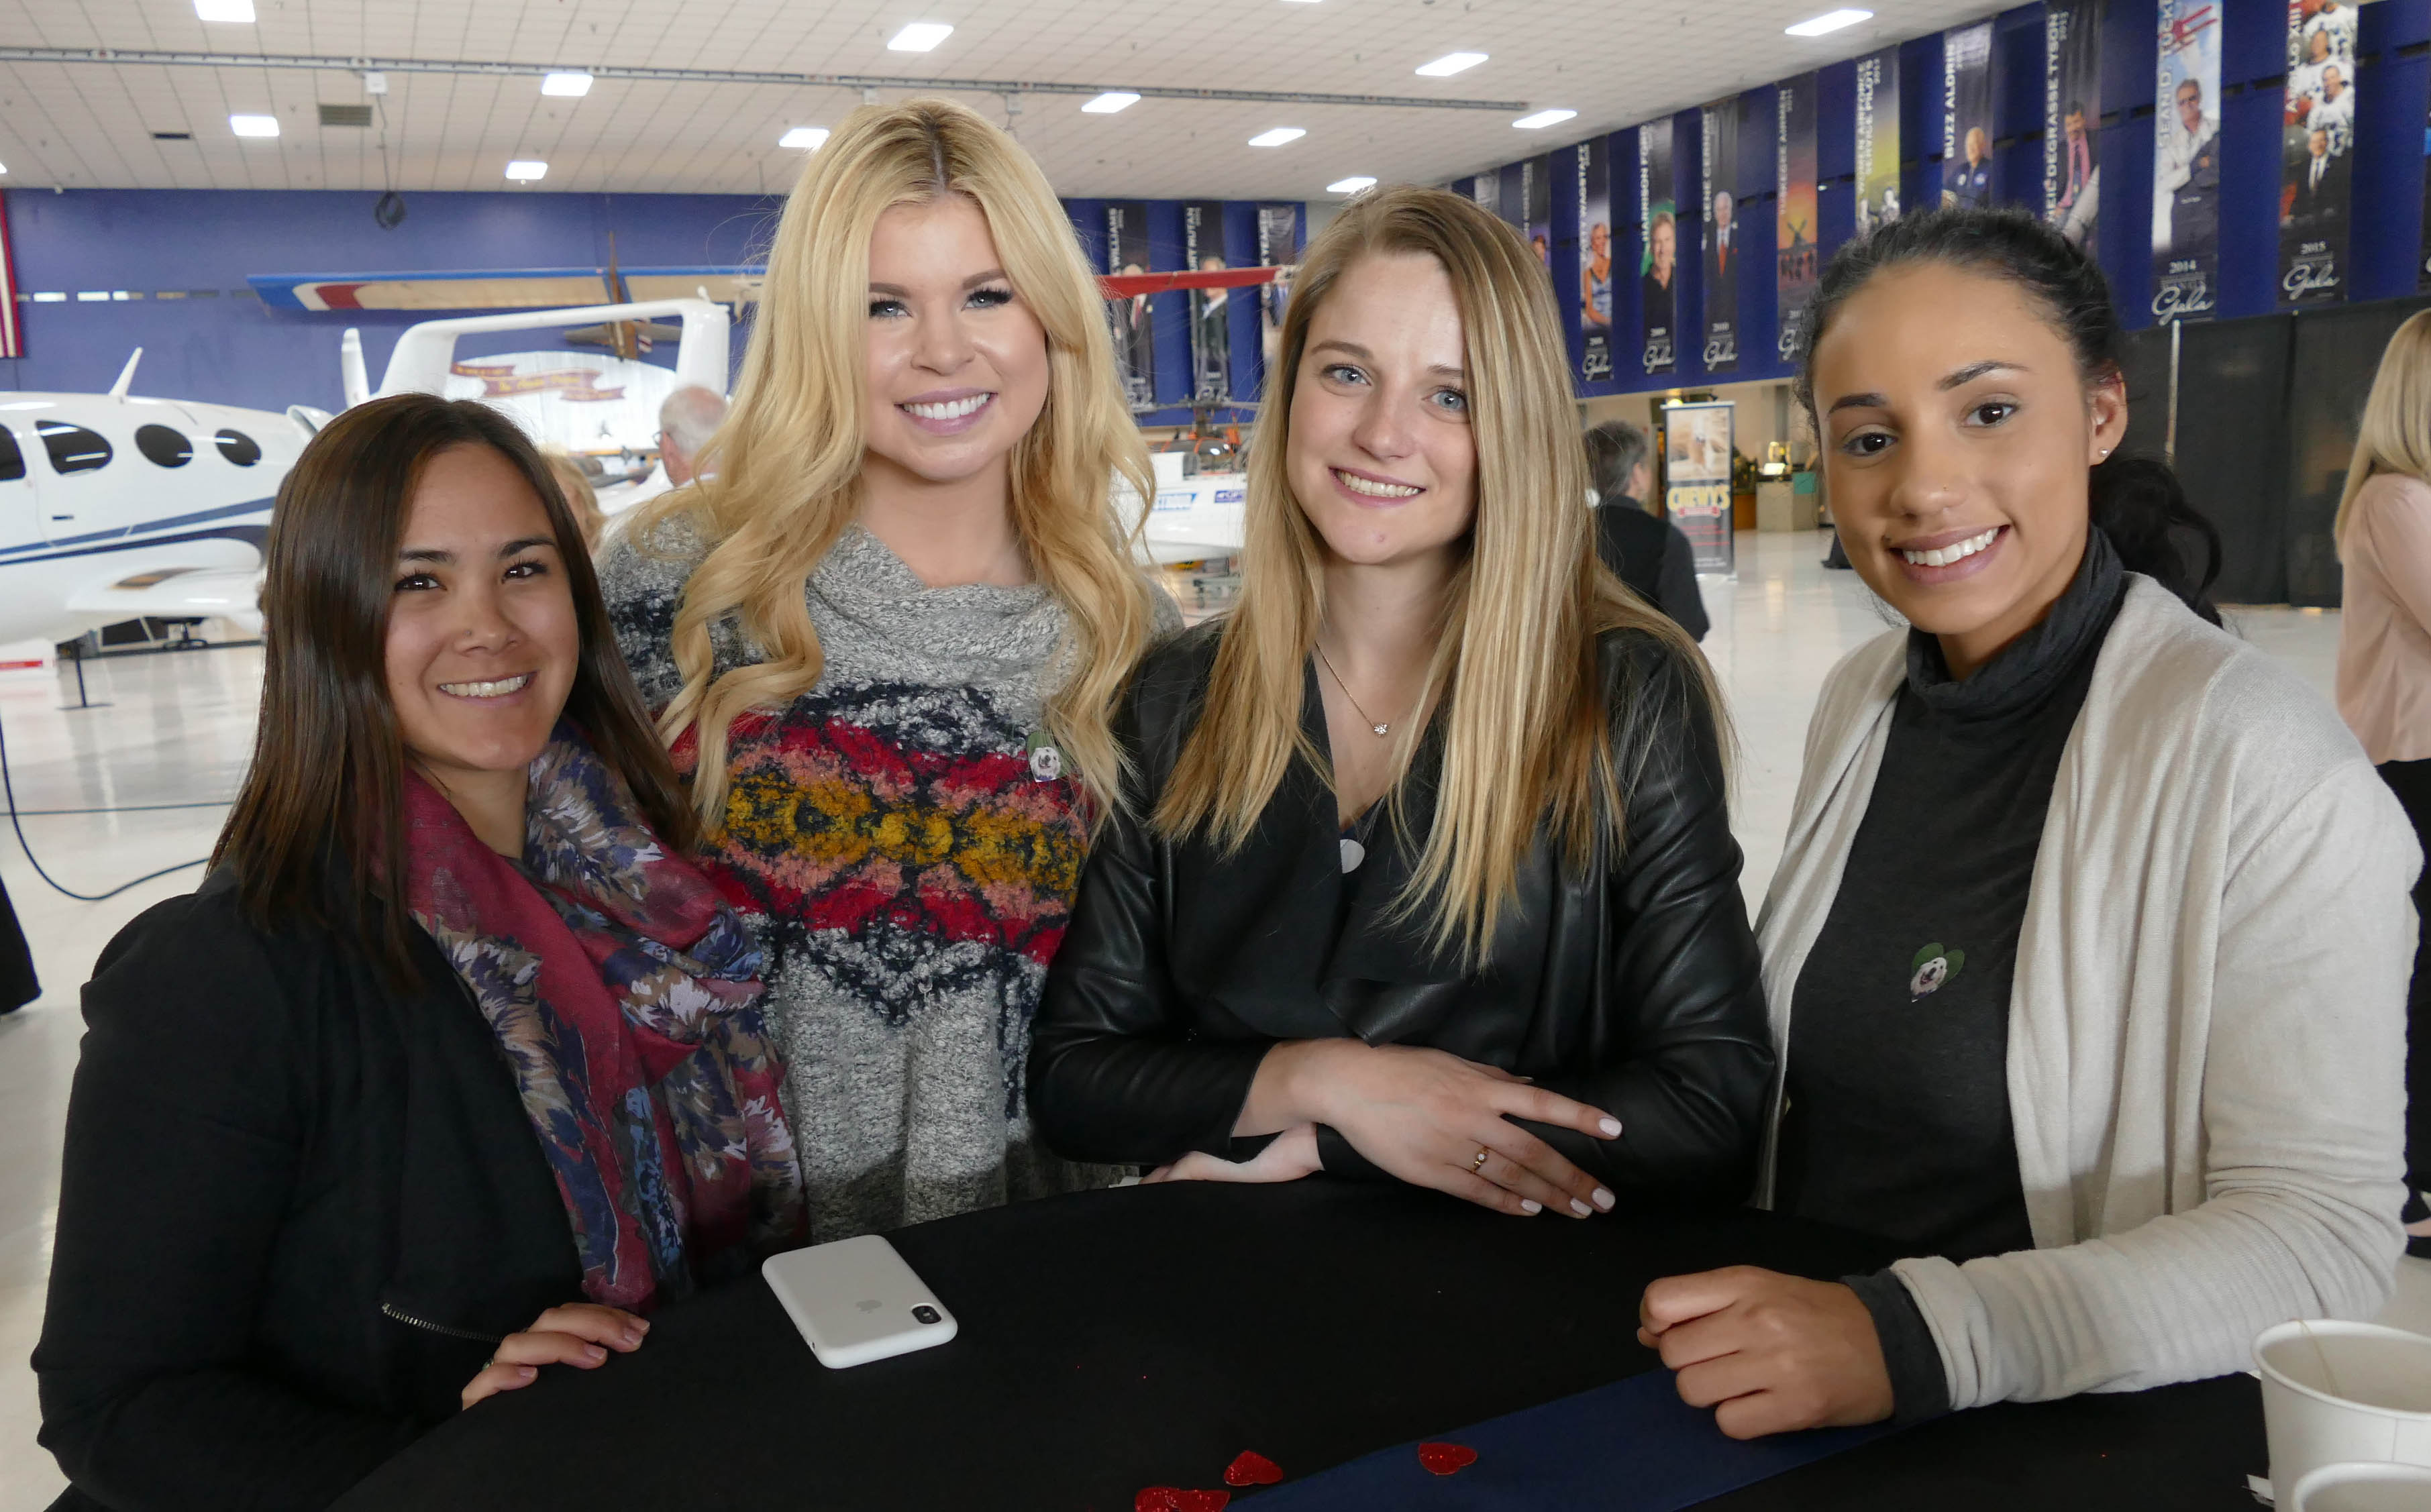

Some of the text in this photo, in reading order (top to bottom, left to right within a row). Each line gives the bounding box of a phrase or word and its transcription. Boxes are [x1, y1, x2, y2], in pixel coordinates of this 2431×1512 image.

[2047, 13, 2059, 75] TYSON
[1857, 63, 1865, 135] AIRFORCE
[1865, 60, 1874, 111] PILOTS
[1944, 44, 1955, 158] BUZZ ALDRIN
[2047, 77, 2058, 177] DEGRASSE
[1640, 167, 1649, 242] HARRISON
[1702, 180, 1712, 222] GENE
[2169, 260, 2196, 274] 2014
[2282, 260, 2340, 301] Gala
[2152, 281, 2214, 326] Gala
[1667, 484, 1730, 512] CHEWY'S
